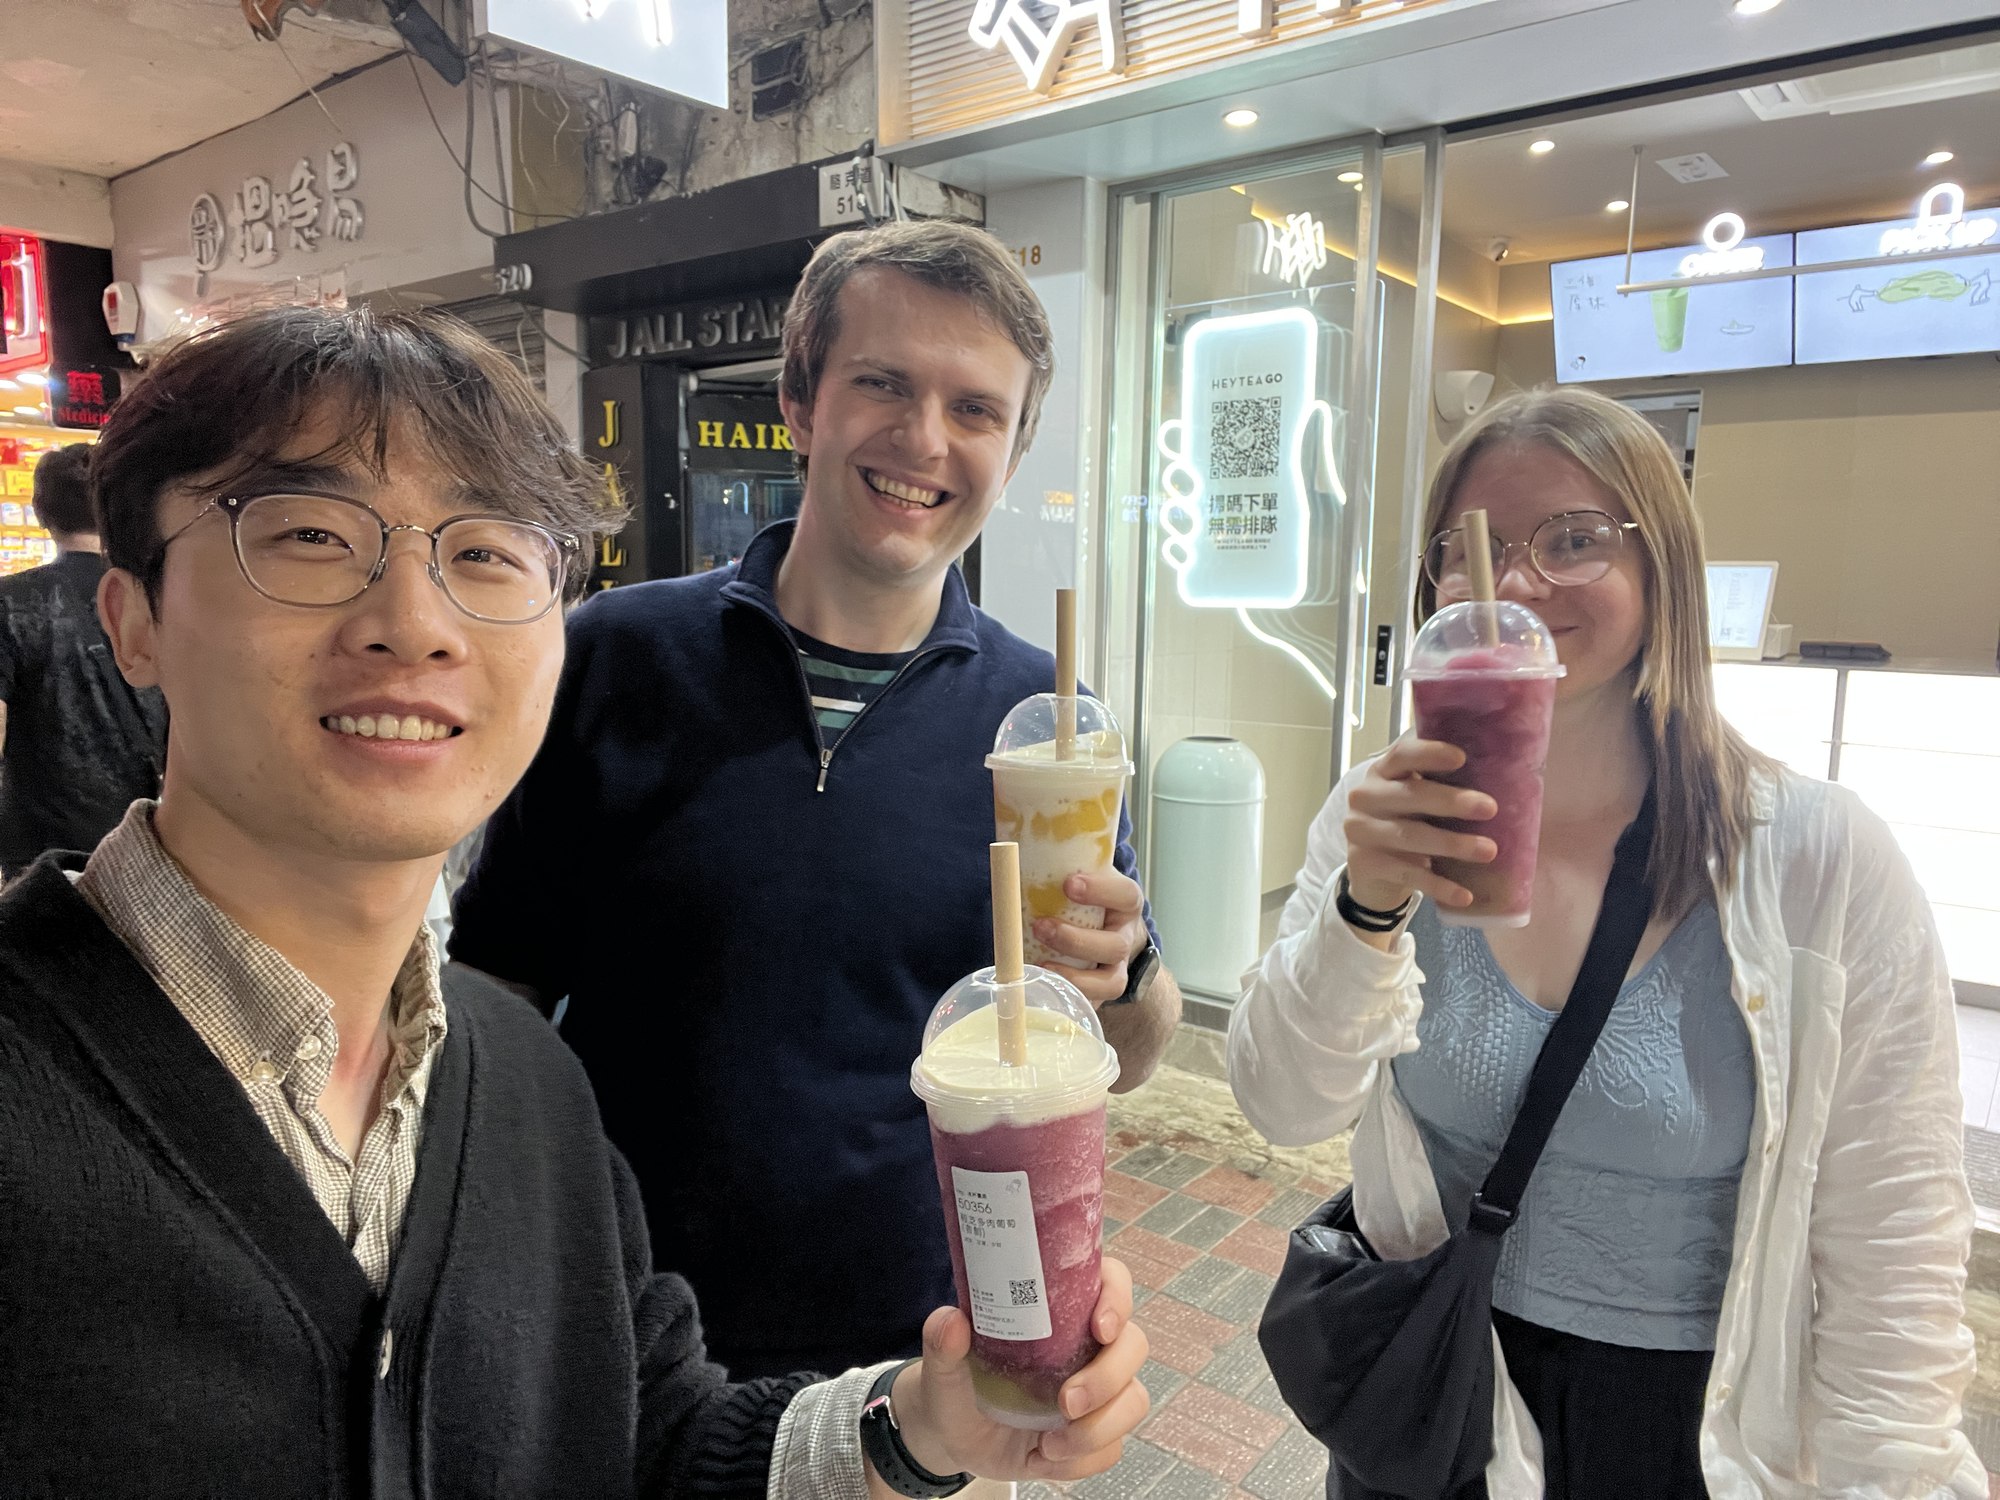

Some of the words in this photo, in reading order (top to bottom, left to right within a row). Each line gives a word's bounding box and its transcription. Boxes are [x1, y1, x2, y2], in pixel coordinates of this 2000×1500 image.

[1009, 244, 1041, 267] 18
[607, 311, 692, 358] JALL
[697, 420, 794, 450] HAIR
[1209, 492, 1279, 513] 掃碼下單
[1208, 514, 1278, 535] 無需排隊
[958, 1197, 992, 1214] 50356
